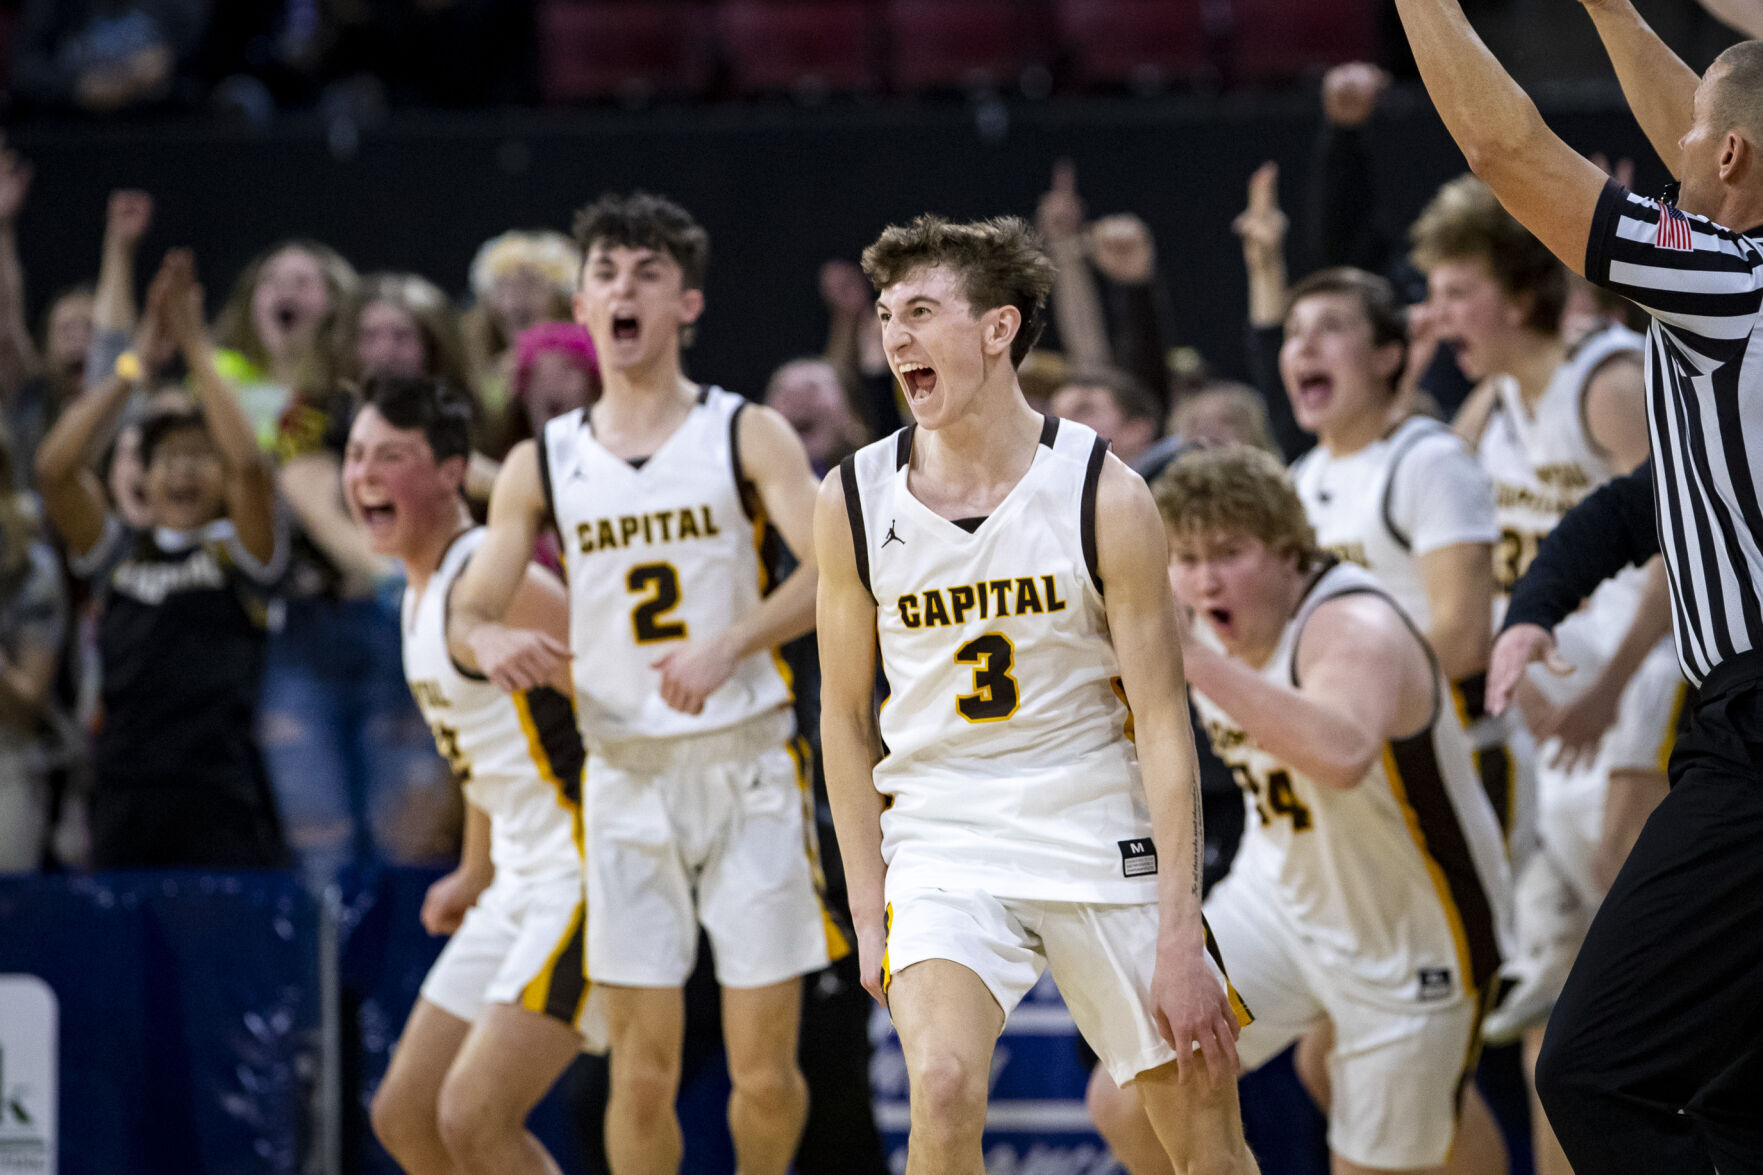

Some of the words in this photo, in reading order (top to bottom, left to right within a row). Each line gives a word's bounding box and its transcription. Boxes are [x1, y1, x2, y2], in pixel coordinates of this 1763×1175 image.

[576, 505, 720, 554] CAPITAL
[624, 559, 690, 647] 2
[897, 574, 1066, 629] CAPITAL
[953, 631, 1021, 724] 3
[1130, 842, 1145, 854] M
